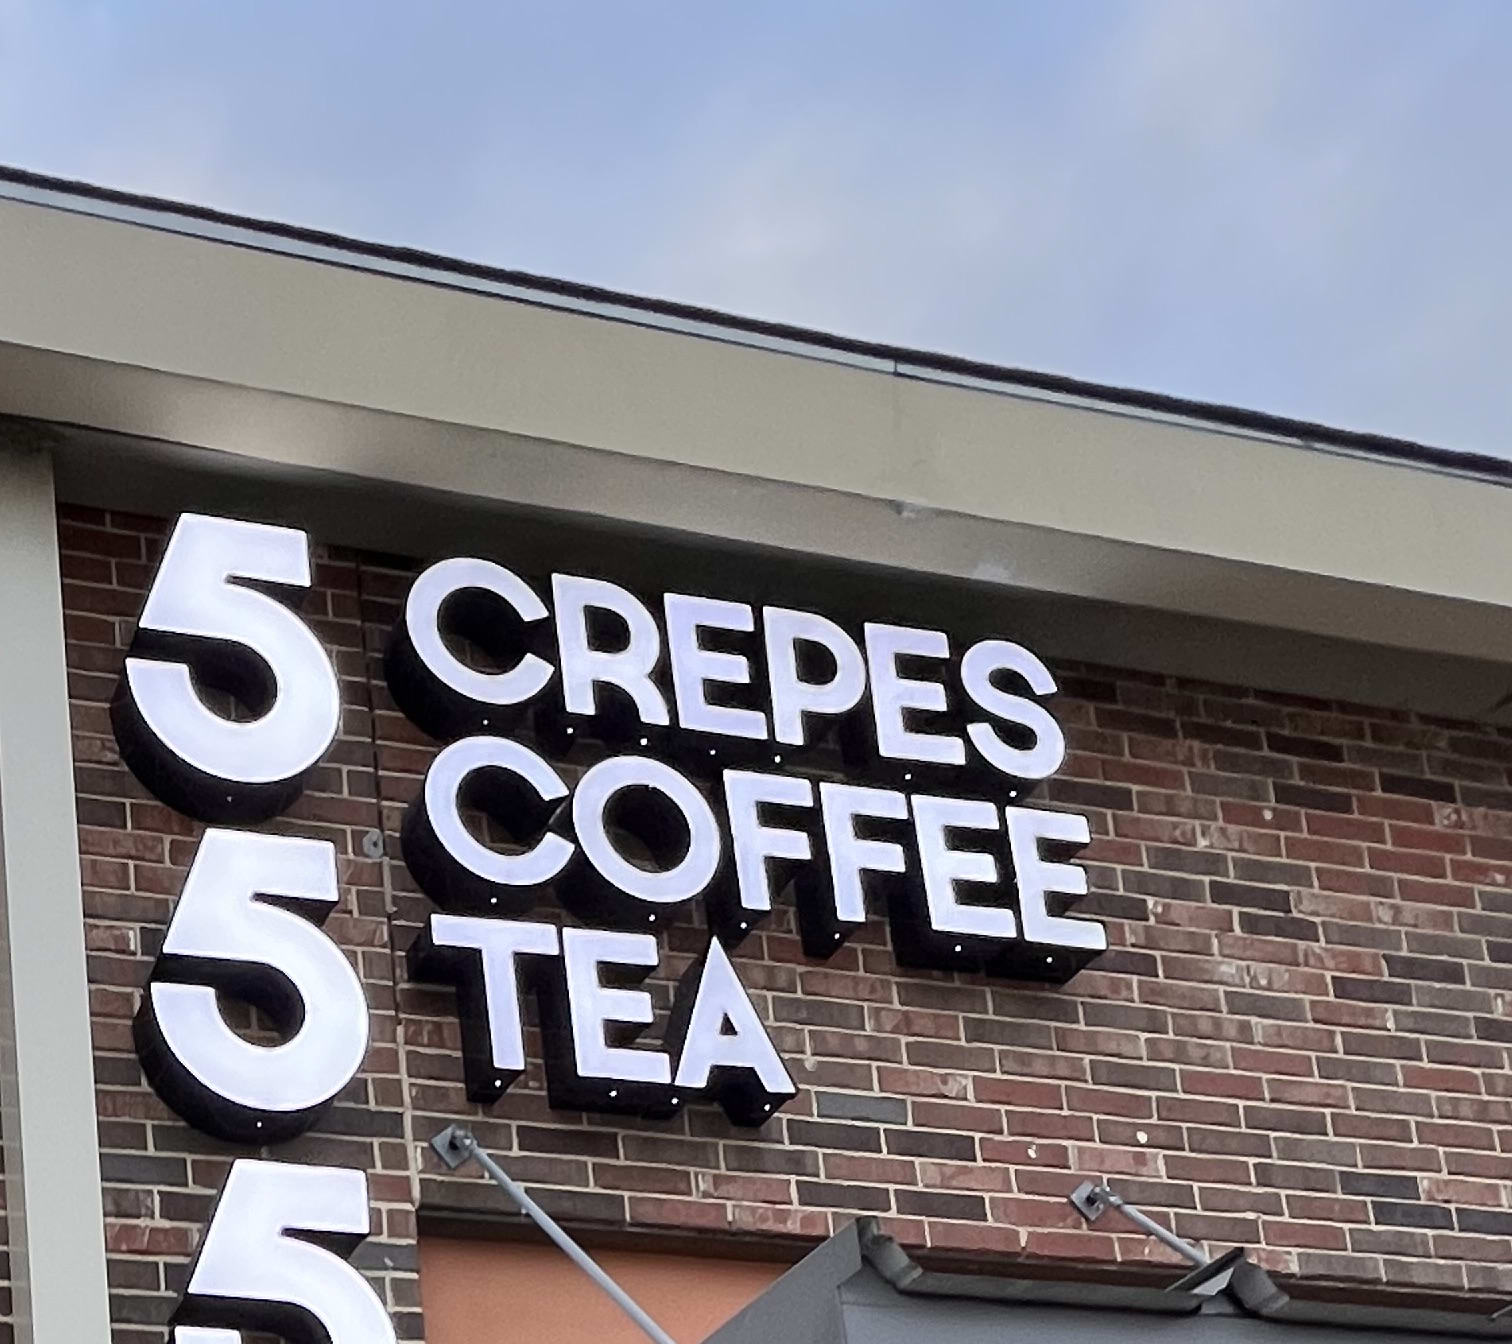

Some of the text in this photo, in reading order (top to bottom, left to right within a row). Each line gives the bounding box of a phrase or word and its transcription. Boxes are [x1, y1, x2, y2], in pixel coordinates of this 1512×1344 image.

[124, 511, 341, 785] 5
[404, 556, 1066, 780] CREPES
[423, 735, 1108, 952] COFFEE
[149, 827, 371, 1113] 5
[429, 913, 797, 1096] TEA
